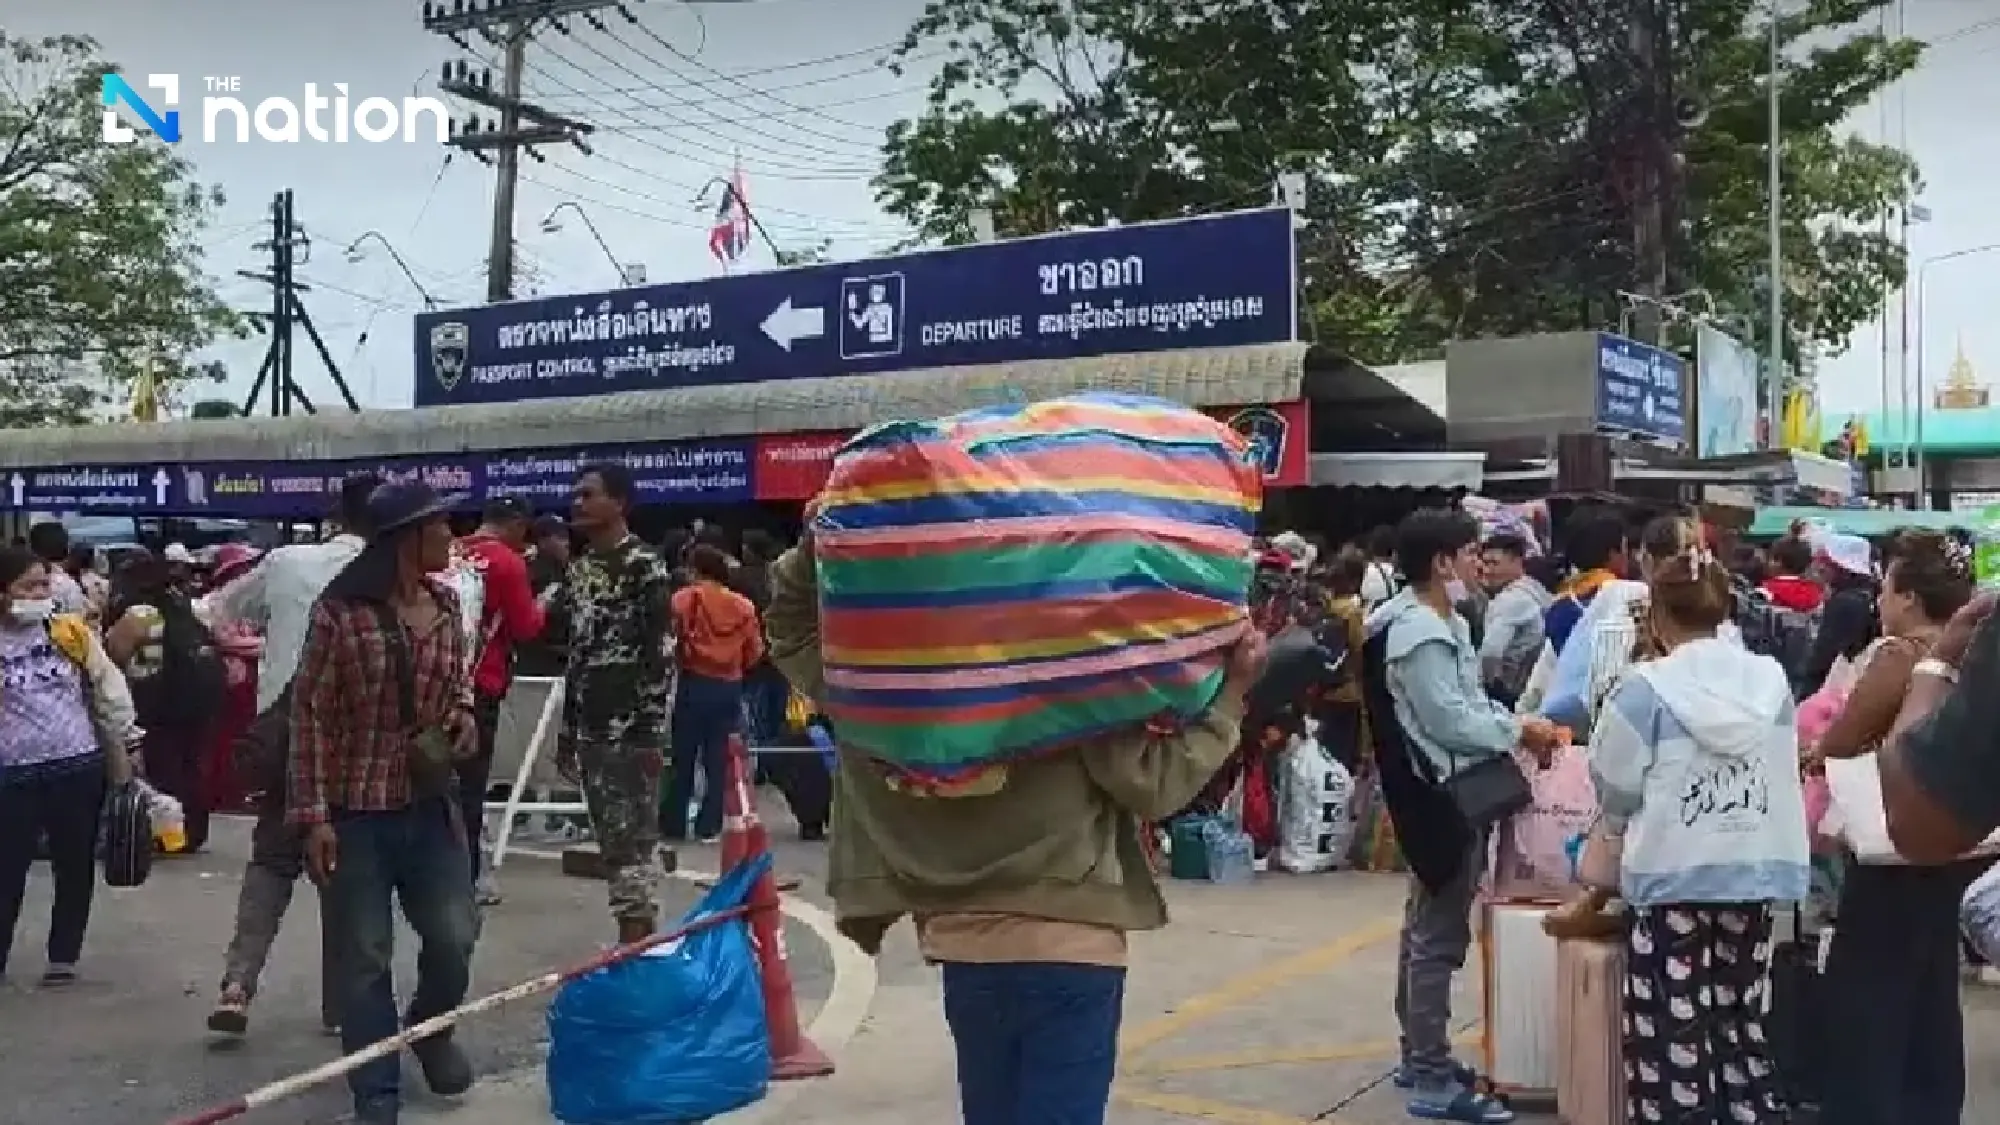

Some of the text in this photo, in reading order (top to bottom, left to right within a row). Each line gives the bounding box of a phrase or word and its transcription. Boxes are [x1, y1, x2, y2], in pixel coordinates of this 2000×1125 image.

[1038, 255, 1143, 294] ขาออก
[921, 315, 1022, 345] DEPARTURE
[471, 356, 597, 383] PASSPORT CONTROL
